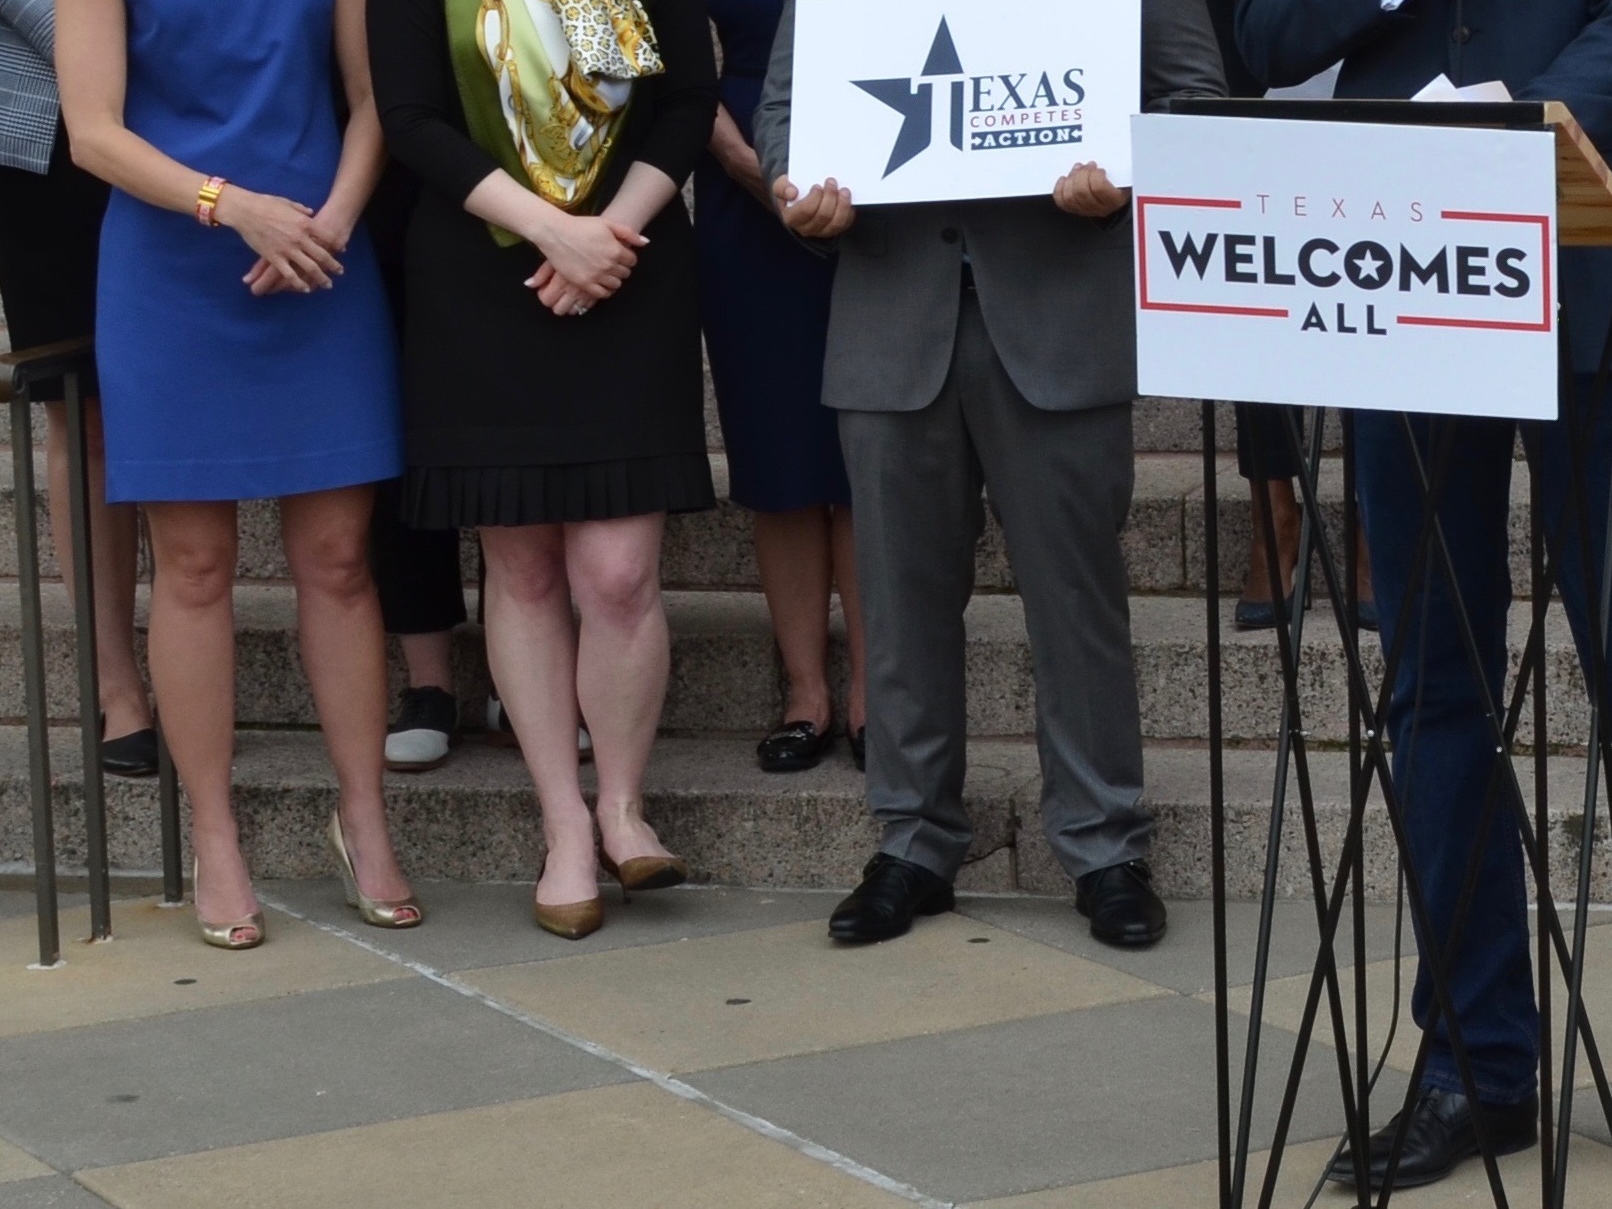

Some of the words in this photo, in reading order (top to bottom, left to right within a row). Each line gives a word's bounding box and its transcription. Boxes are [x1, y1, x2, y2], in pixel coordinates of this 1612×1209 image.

[970, 108, 1082, 128] COMPETES
[983, 128, 1071, 148] ACTION
[1256, 194, 1423, 223] TEXAS
[1158, 230, 1531, 298] WELCOMES
[1300, 301, 1388, 336] ALL
